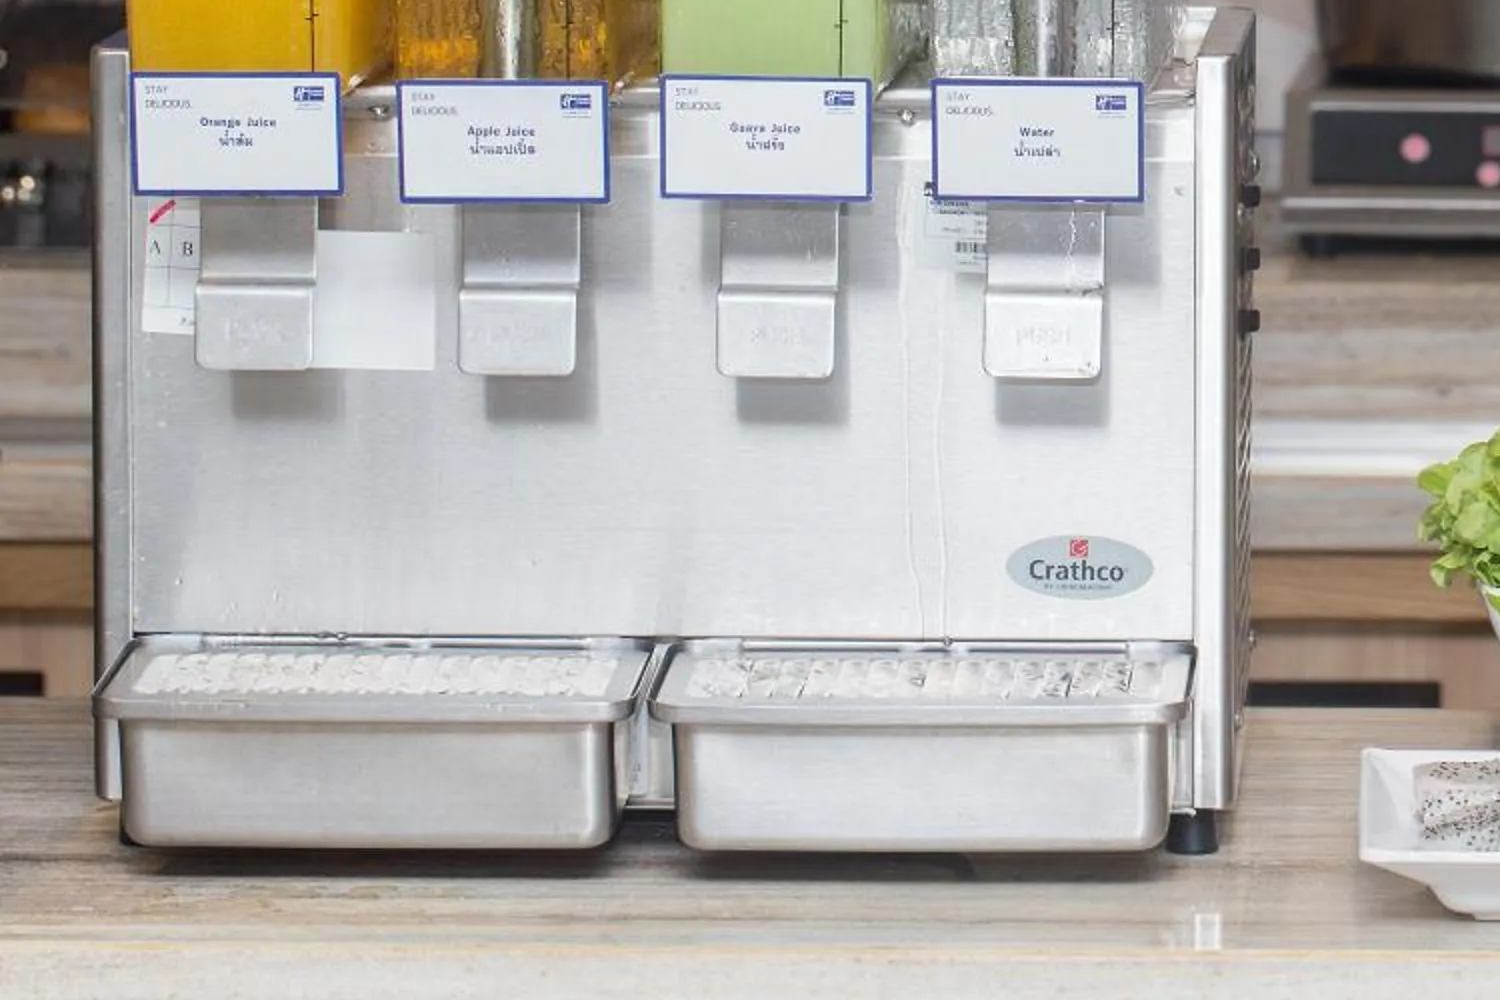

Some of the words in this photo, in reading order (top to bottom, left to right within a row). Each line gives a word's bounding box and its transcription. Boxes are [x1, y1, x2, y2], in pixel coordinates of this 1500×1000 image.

[200, 117, 241, 129] Orange
[247, 117, 277, 127] Juice
[771, 122, 801, 133] Juice
[467, 126, 501, 138] Apple
[505, 126, 536, 137] Juice
[1019, 127, 1055, 137] Water
[183, 241, 193, 255] B
[1029, 559, 1124, 581] Crathco
